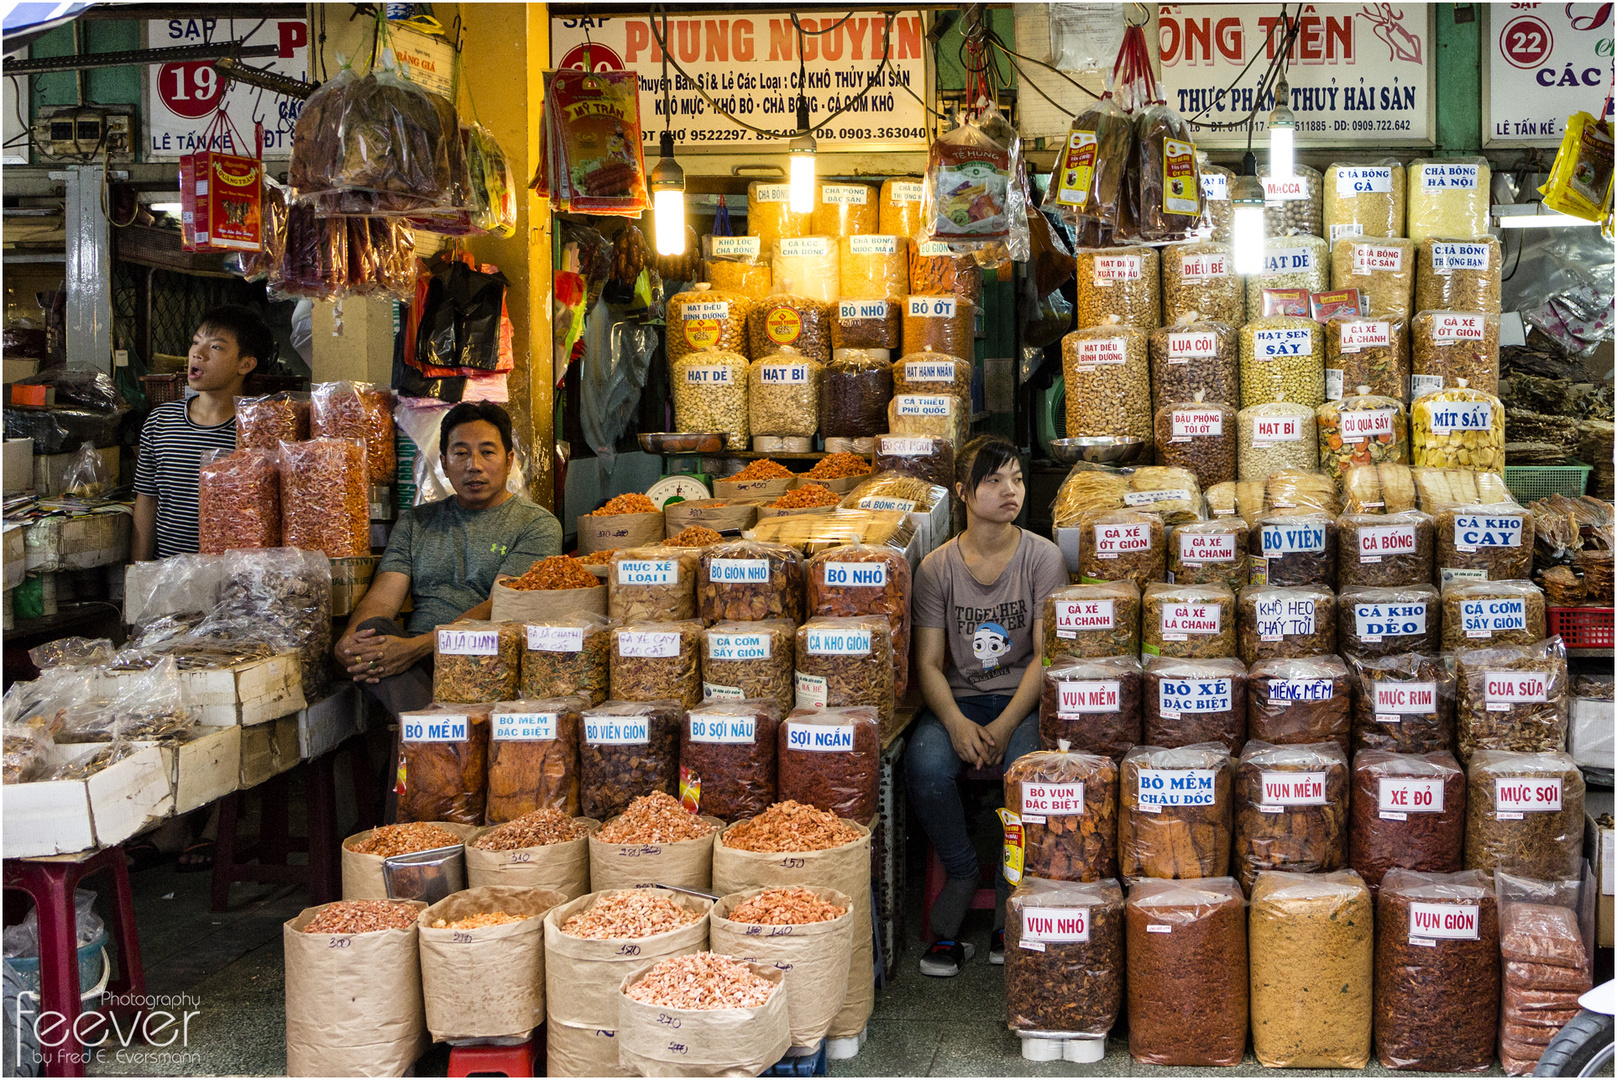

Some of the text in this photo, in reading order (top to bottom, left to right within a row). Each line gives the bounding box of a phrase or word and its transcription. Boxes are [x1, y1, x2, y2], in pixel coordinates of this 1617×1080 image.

[169, 19, 216, 40] SẠP
[625, 19, 754, 63] PHUNG
[1512, 32, 1541, 53] 22
[397, 50, 420, 66] BẢNG
[421, 60, 435, 72] GIÁ
[722, 71, 734, 89] Lẻ
[737, 72, 756, 89] Các
[760, 73, 781, 93] Loại
[809, 68, 831, 88] KHÔ
[835, 65, 863, 88] THỦY
[889, 64, 910, 86] SẢN
[1536, 63, 1601, 86] CÁC
[170, 66, 218, 101] 19
[655, 95, 677, 115] KHÔ
[681, 94, 704, 119] MỰC
[714, 94, 736, 113] KHÔ
[740, 93, 753, 113] BÒ
[763, 93, 784, 113] CHÀ
[828, 92, 841, 113] CÁ
[872, 91, 894, 112] KHÔ
[1178, 86, 1226, 118] THỰC
[1344, 77, 1376, 110] HẢI
[1379, 77, 1416, 110] SẢN
[691, 130, 747, 140] 9522297
[840, 128, 926, 139] 0903.363040
[1352, 120, 1410, 131] 0909.722.642
[1496, 118, 1556, 135] LÊ TẤN KẾ
[153, 137, 174, 150] LÊ
[179, 131, 208, 150] TẤN
[213, 132, 232, 149] KẾ
[1362, 166, 1389, 179] BÔNG
[1267, 183, 1300, 194] MACCA
[1354, 179, 1373, 191] GÀ
[1428, 175, 1473, 189] HÀ NỘI
[913, 302, 951, 315] BÒ ỚT
[1257, 330, 1308, 341] HẠT SEN
[1266, 339, 1302, 355] SẤY
[688, 367, 727, 384] HẠT DẺ
[763, 365, 804, 383] HẠT BÍ
[1434, 405, 1487, 426] MÍT SẤY
[1259, 420, 1294, 435] HẠT BÍ
[1457, 516, 1520, 528] CÁ KHO
[1105, 526, 1140, 538] GÀ XÉ
[1264, 525, 1322, 550] BÒ VIÊN
[1363, 529, 1412, 550] CÁ BỐNG
[1464, 532, 1514, 545] CAY
[1100, 538, 1147, 549] ỚT GIÒN
[1192, 535, 1222, 547] GÀ XÉ
[1184, 547, 1232, 558] LÁ CHANH
[828, 565, 883, 584] BÒ NHỎ
[955, 599, 1027, 621] TOGETHER
[1068, 603, 1099, 614] GÀ XÉ
[1175, 606, 1206, 617] GÀ XÉ
[1260, 599, 1314, 616] KHÔ HEO
[1358, 605, 1423, 616] CÁ KHO
[1465, 602, 1521, 615] CÁ CƠM
[1060, 615, 1109, 626] LÁ CHANH
[1165, 617, 1215, 629] LÁ CHANH
[1257, 616, 1286, 635] CHÁY
[1367, 618, 1418, 634] DẺO
[810, 633, 868, 650] CÁ KHO GIÒN
[1164, 679, 1226, 695] BÒ XÉ
[1488, 678, 1544, 696] CUA SỮA
[1063, 685, 1116, 708] VỤN MỀM
[1379, 689, 1431, 707] MỰC RIM
[406, 720, 465, 738] BÒ MỀM
[587, 722, 645, 739] BÒ VIÊN GIÒN
[1141, 772, 1212, 789] BÒ MỀM
[1266, 777, 1322, 800] VỤN MỀM
[1141, 790, 1212, 803] CHÂU ĐỐC
[1391, 786, 1432, 805] XÉ ĐỎ
[1028, 913, 1084, 935] VỤN NHỎ
[1415, 911, 1474, 931] VỤN GIÒN
